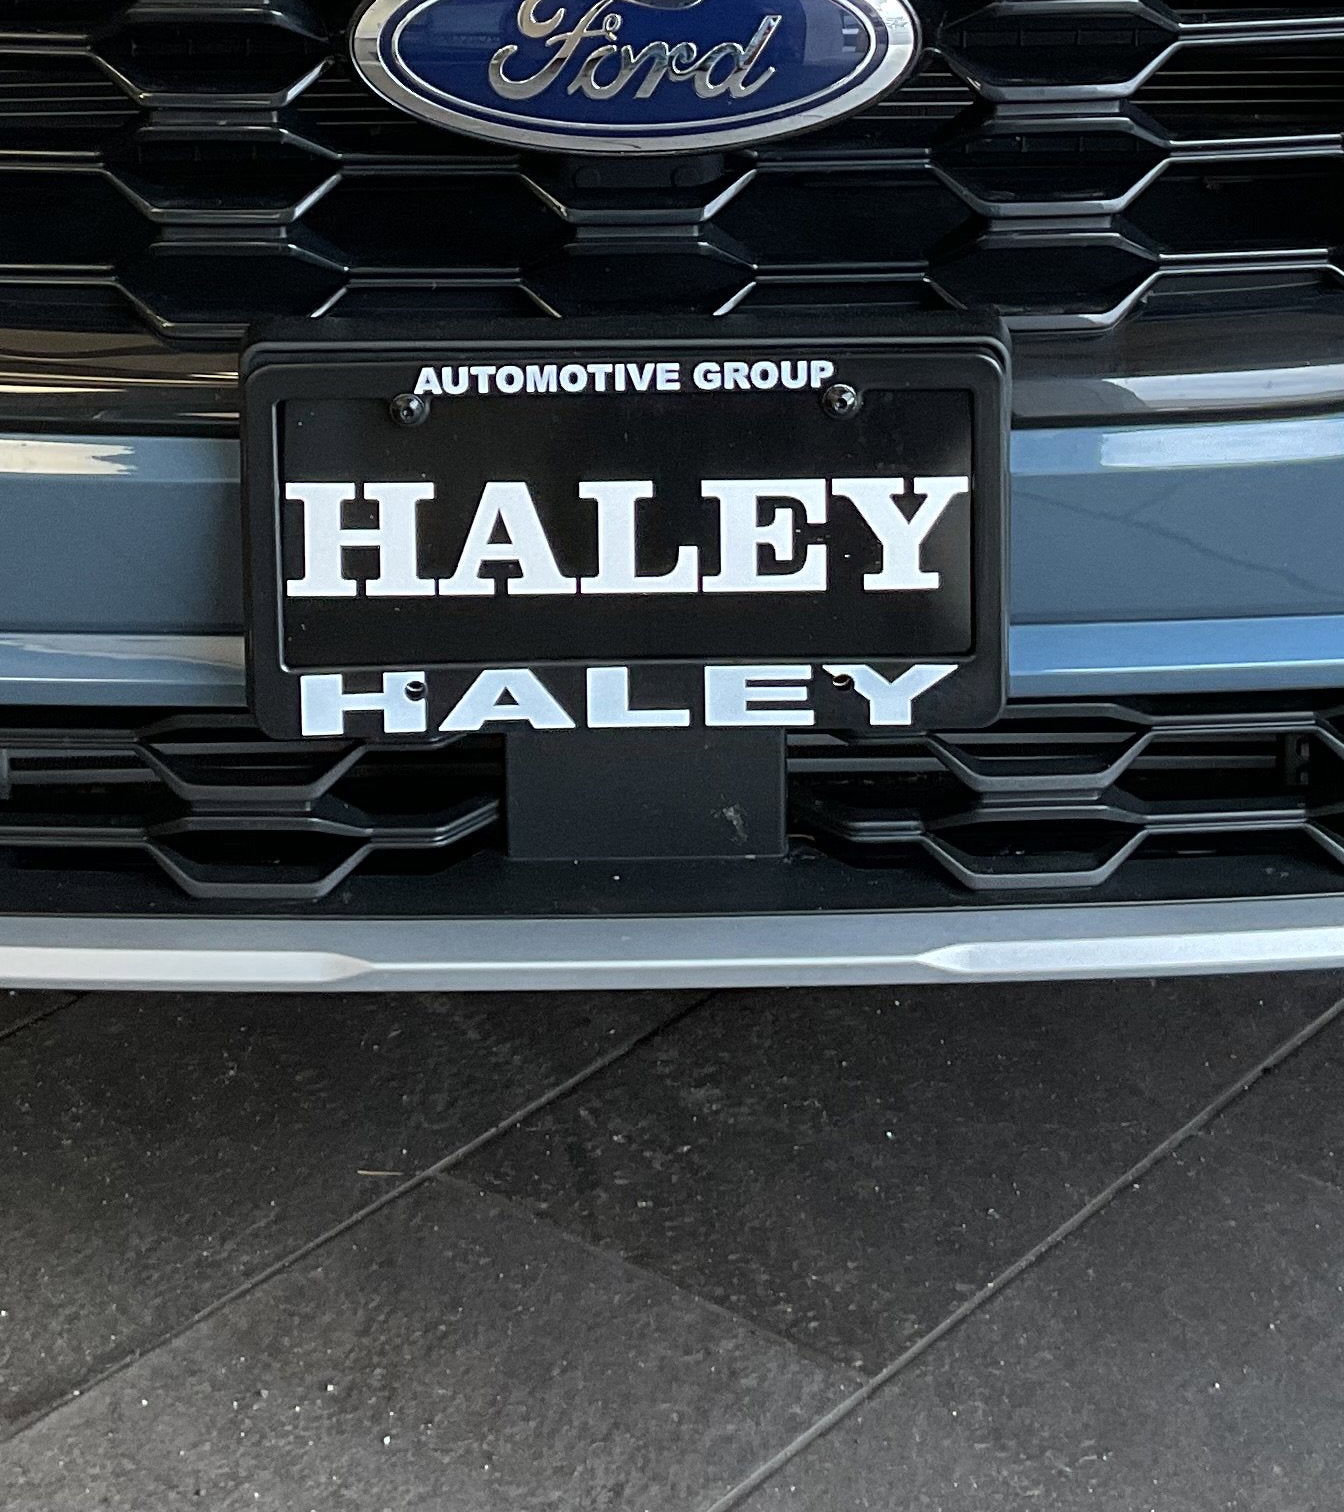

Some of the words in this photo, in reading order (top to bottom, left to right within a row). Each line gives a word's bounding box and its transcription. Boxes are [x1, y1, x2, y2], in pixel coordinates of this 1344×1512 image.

[413, 362, 681, 396] AUTOMOTIVE
[693, 360, 835, 391] GROUP
[284, 475, 970, 598] HALEY
[299, 664, 959, 737] HALEY
